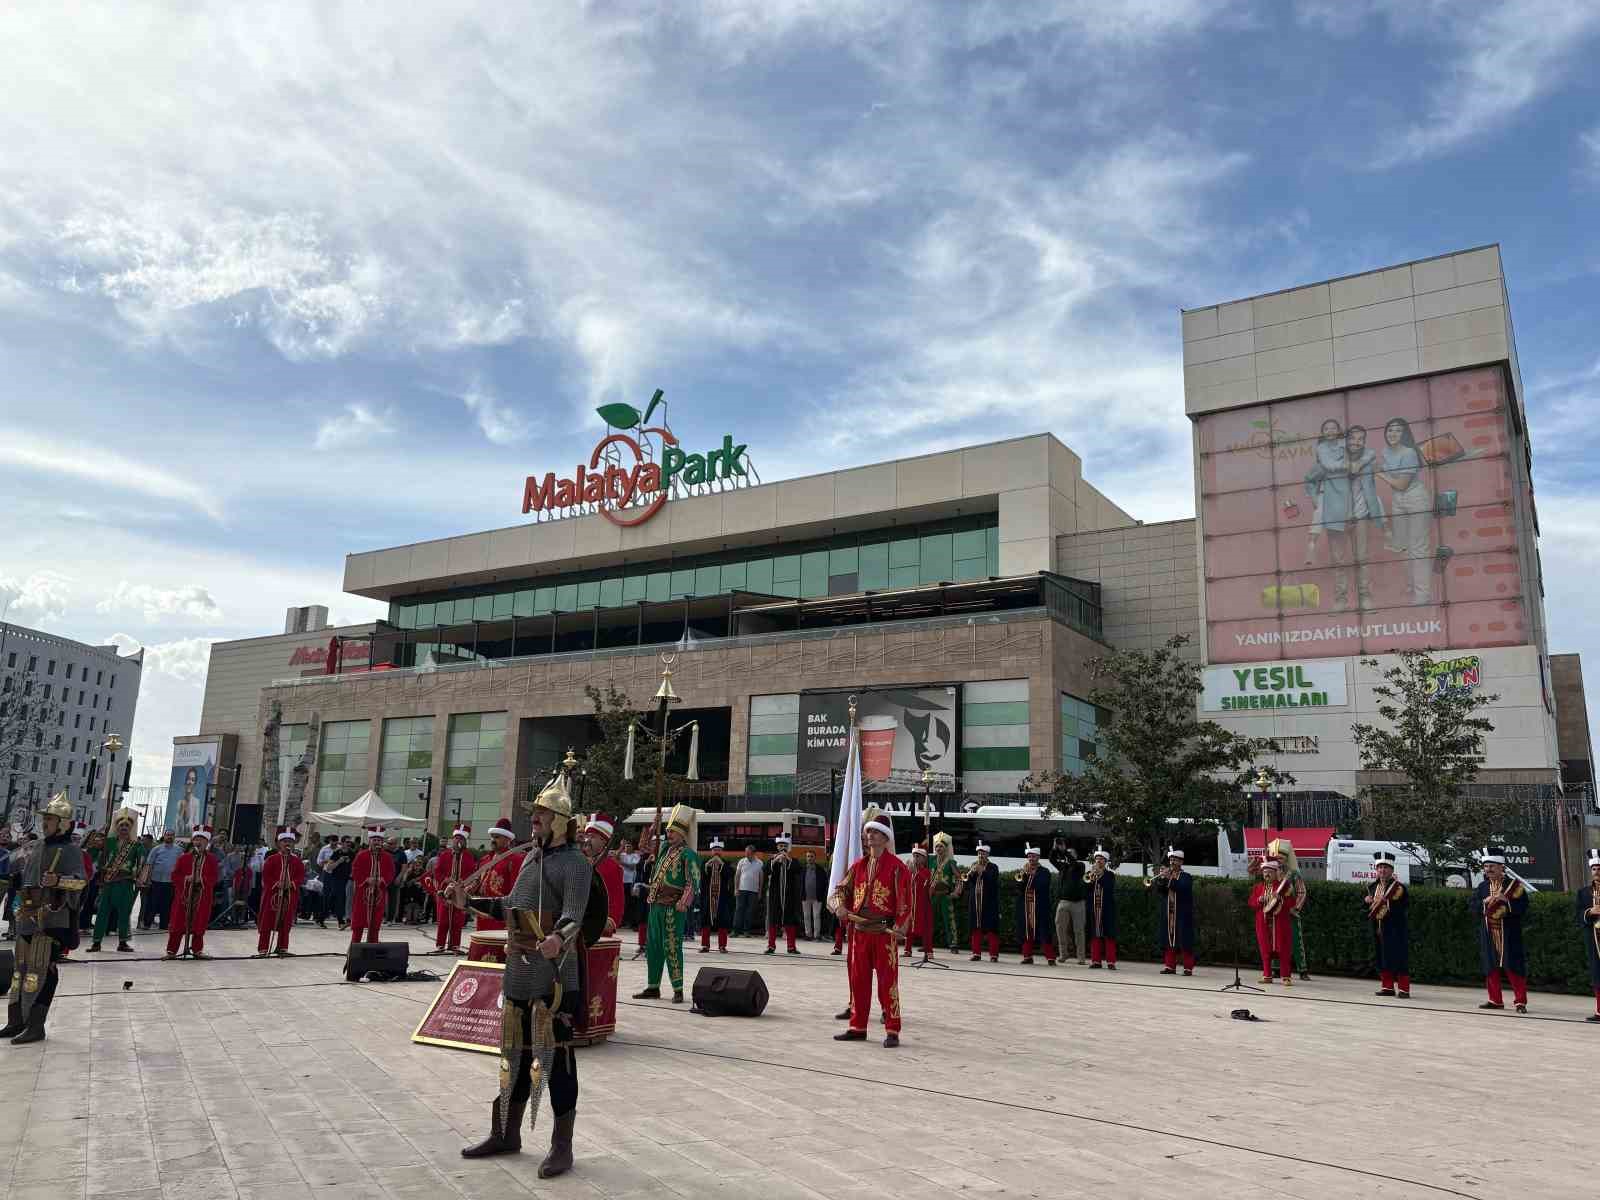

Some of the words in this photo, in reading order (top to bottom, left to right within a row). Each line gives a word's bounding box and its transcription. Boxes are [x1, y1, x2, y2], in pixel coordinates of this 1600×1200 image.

[1346, 620, 1441, 638] MUTLULUK
[807, 714, 828, 723] BAK
[807, 725, 847, 735] BURADA
[807, 736, 825, 748] KİM
